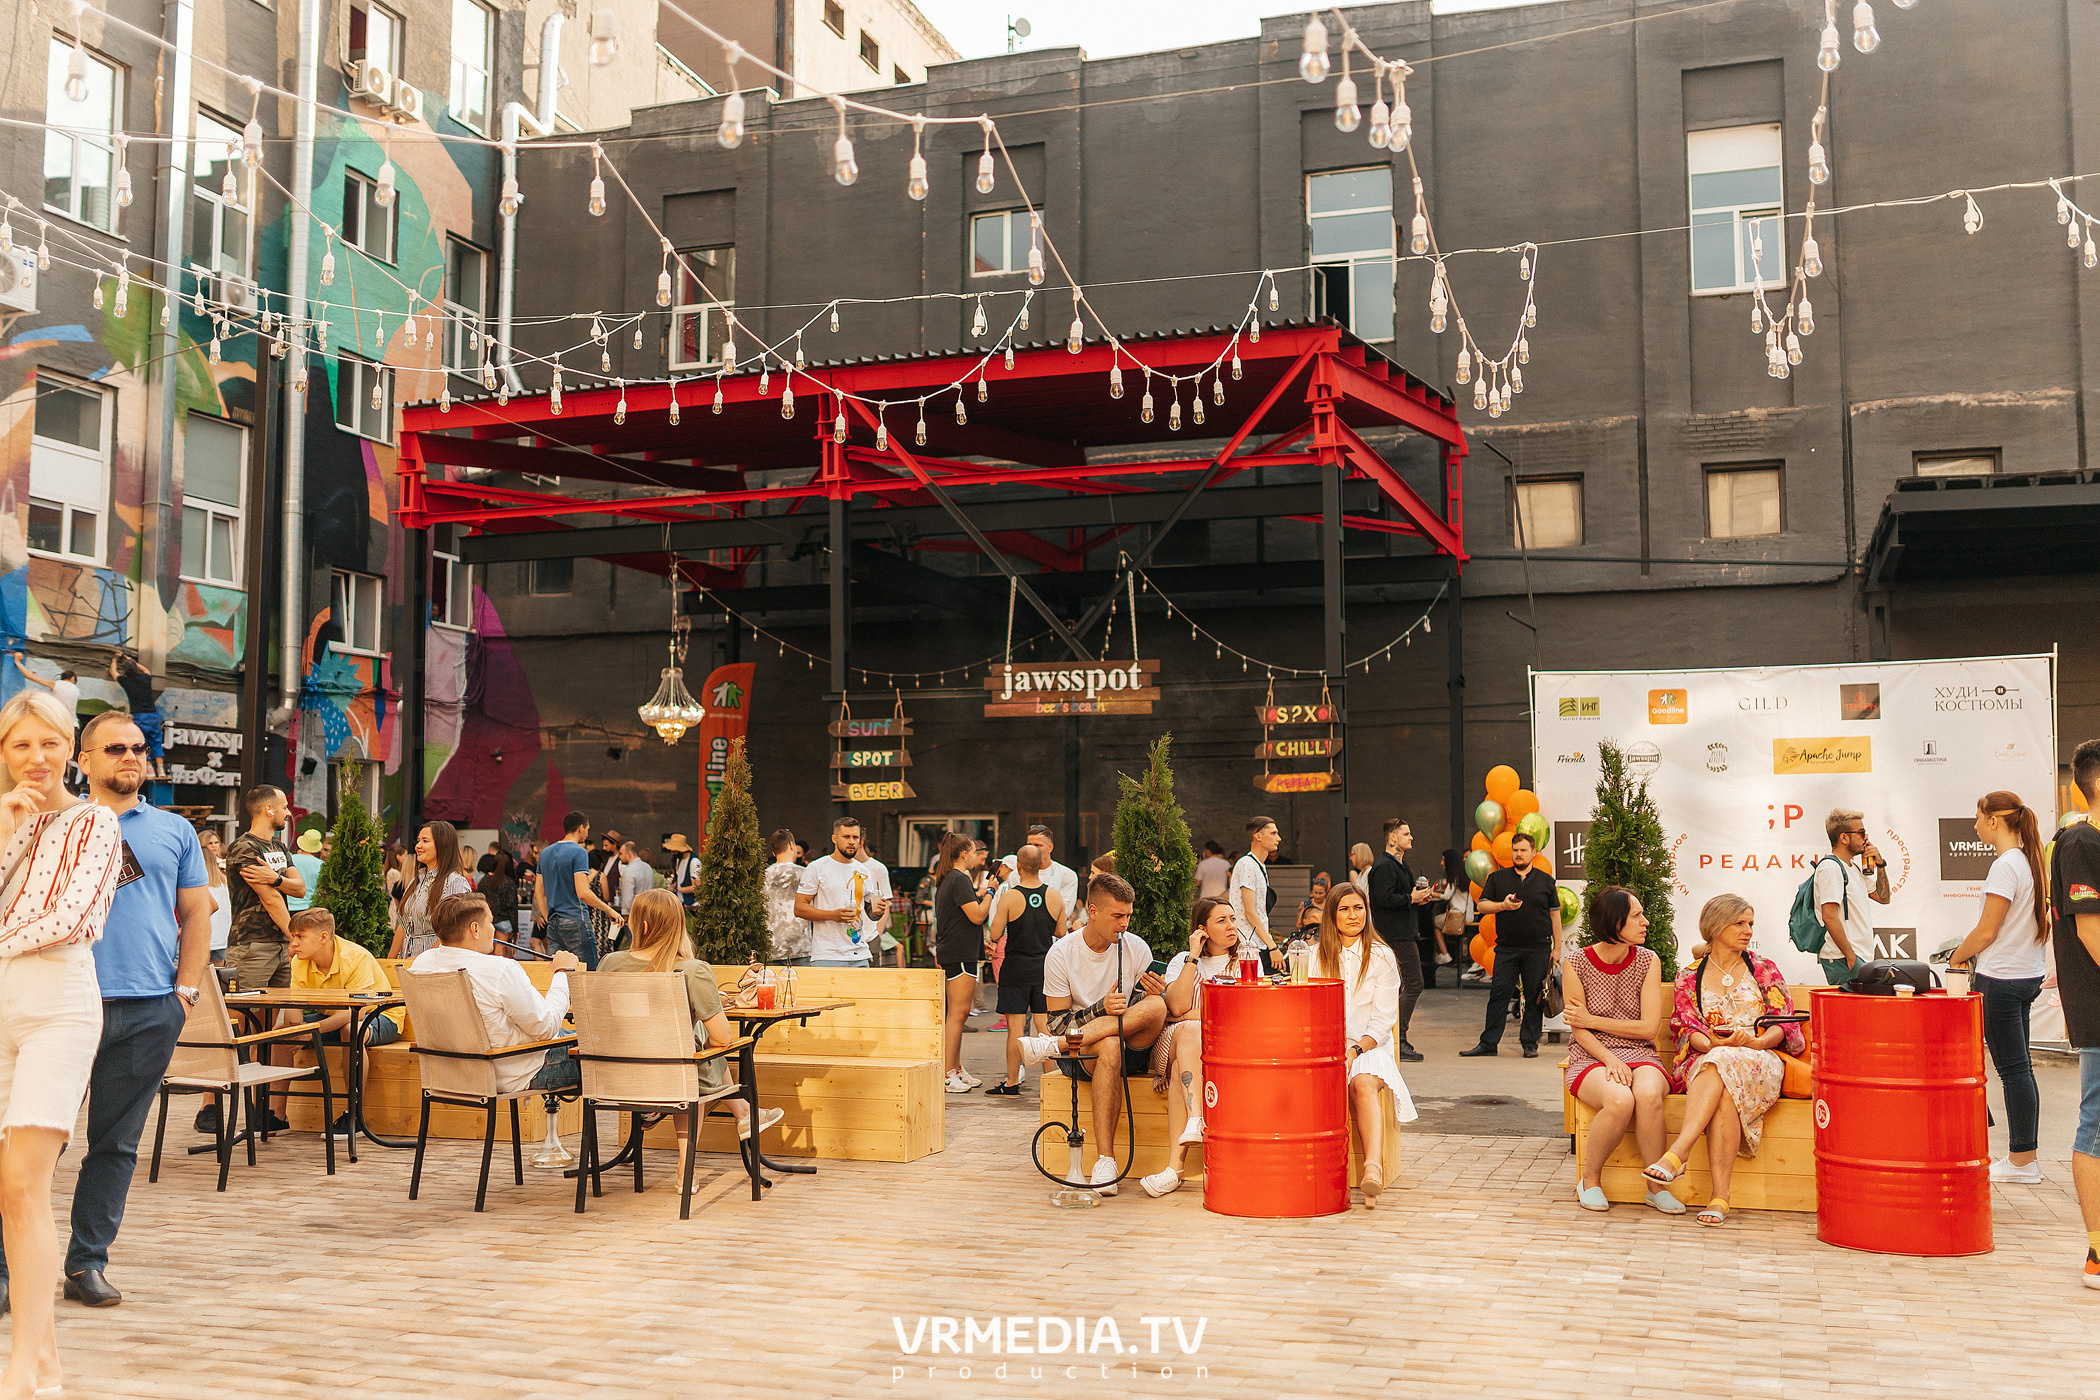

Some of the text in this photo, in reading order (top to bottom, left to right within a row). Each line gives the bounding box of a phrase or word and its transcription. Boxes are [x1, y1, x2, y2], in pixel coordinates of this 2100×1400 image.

[1000, 662, 1142, 701] jawsspot
[1934, 686, 1978, 699] ХУДИ
[1651, 707, 1685, 715] Goodline
[1935, 699, 2023, 712] КОСТЮМЫ
[1276, 740, 1326, 757] CHILL
[1799, 748, 1862, 765] Apache Jump
[851, 751, 894, 767] SPOT
[852, 784, 902, 799] BEER
[1276, 777, 1321, 791] REPEAT
[1699, 854, 1866, 872] РЕДАК
[1886, 829, 1911, 896] пространств
